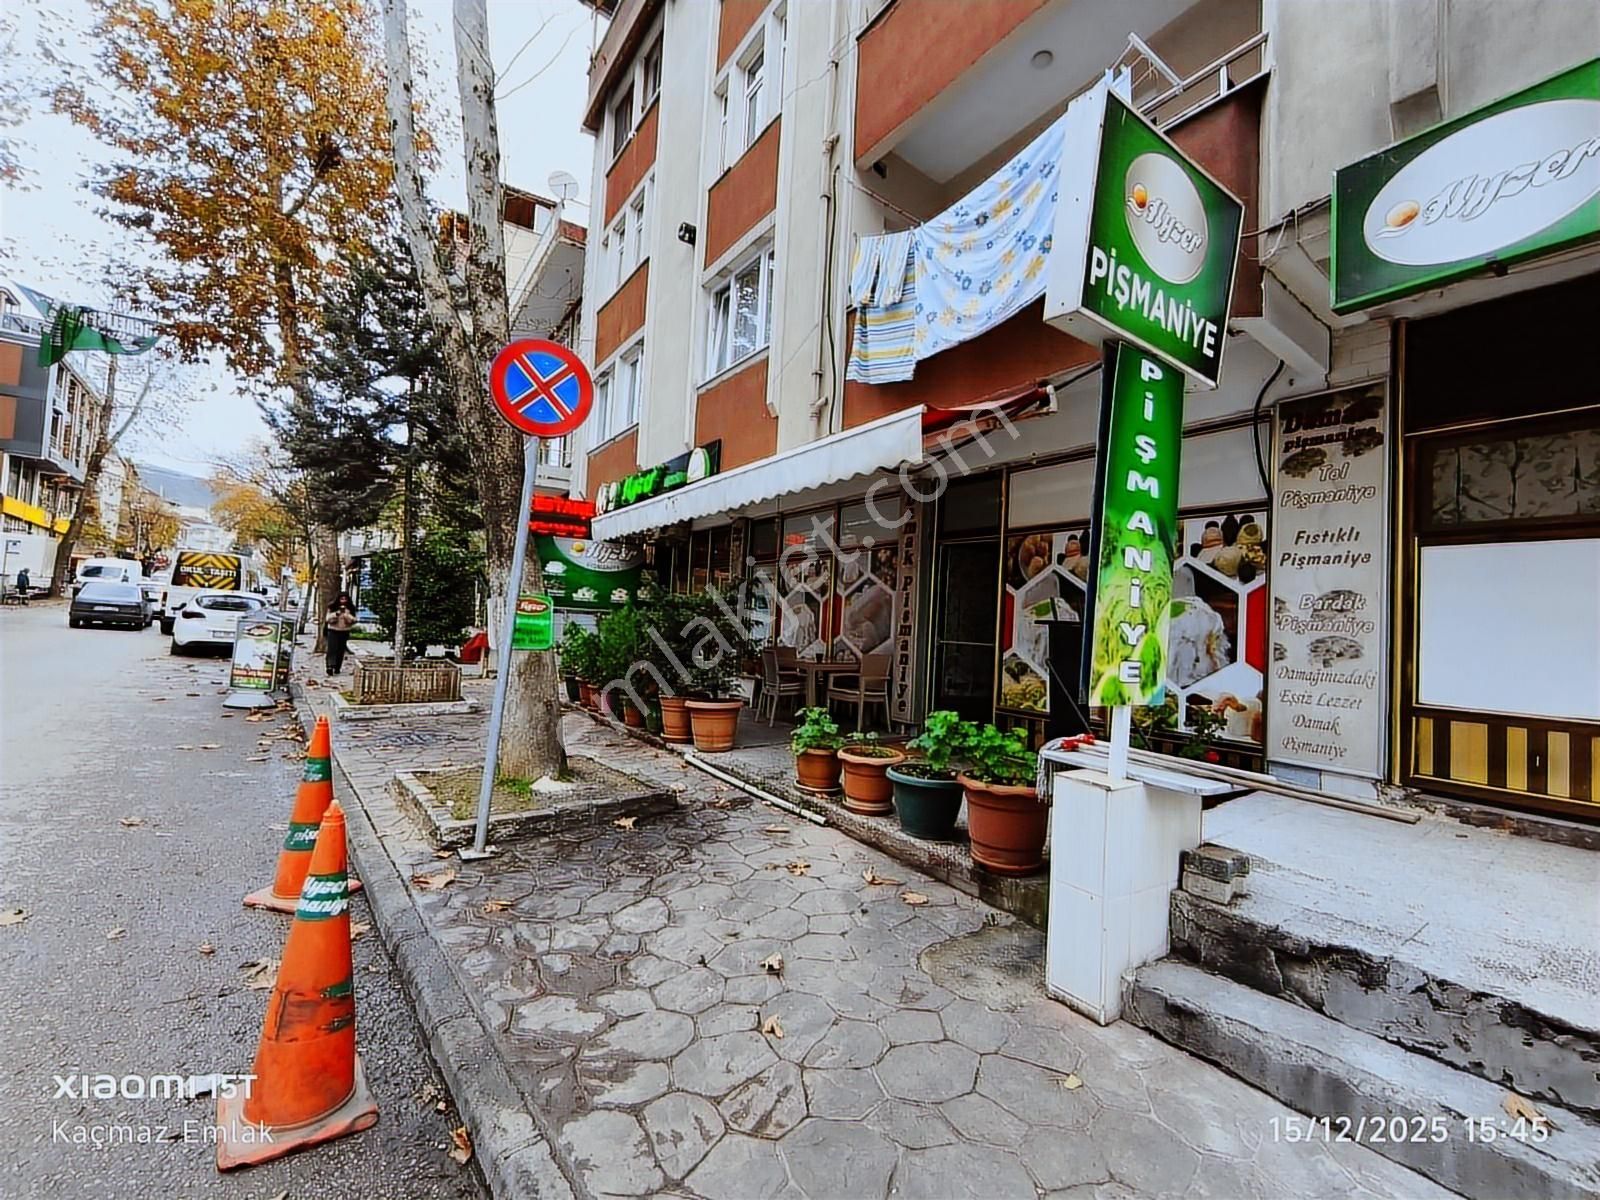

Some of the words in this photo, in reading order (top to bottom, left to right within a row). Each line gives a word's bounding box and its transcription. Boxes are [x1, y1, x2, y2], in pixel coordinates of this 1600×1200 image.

[1089, 245, 1218, 358] PİŞMANİYE
[1280, 484, 1376, 509] Pişmaniye
[1294, 526, 1360, 545] Fıstıklı
[1279, 550, 1371, 570] Pişmaniye
[1300, 593, 1366, 611] Bardak
[1279, 613, 1374, 637] Pişmaniye
[1276, 665, 1377, 690] Damağınızdaki
[1279, 689, 1312, 707] Eşsiz
[1316, 692, 1363, 710] Lezzet
[1292, 714, 1341, 736] Damak
[1281, 735, 1347, 761] Pişmaniye
